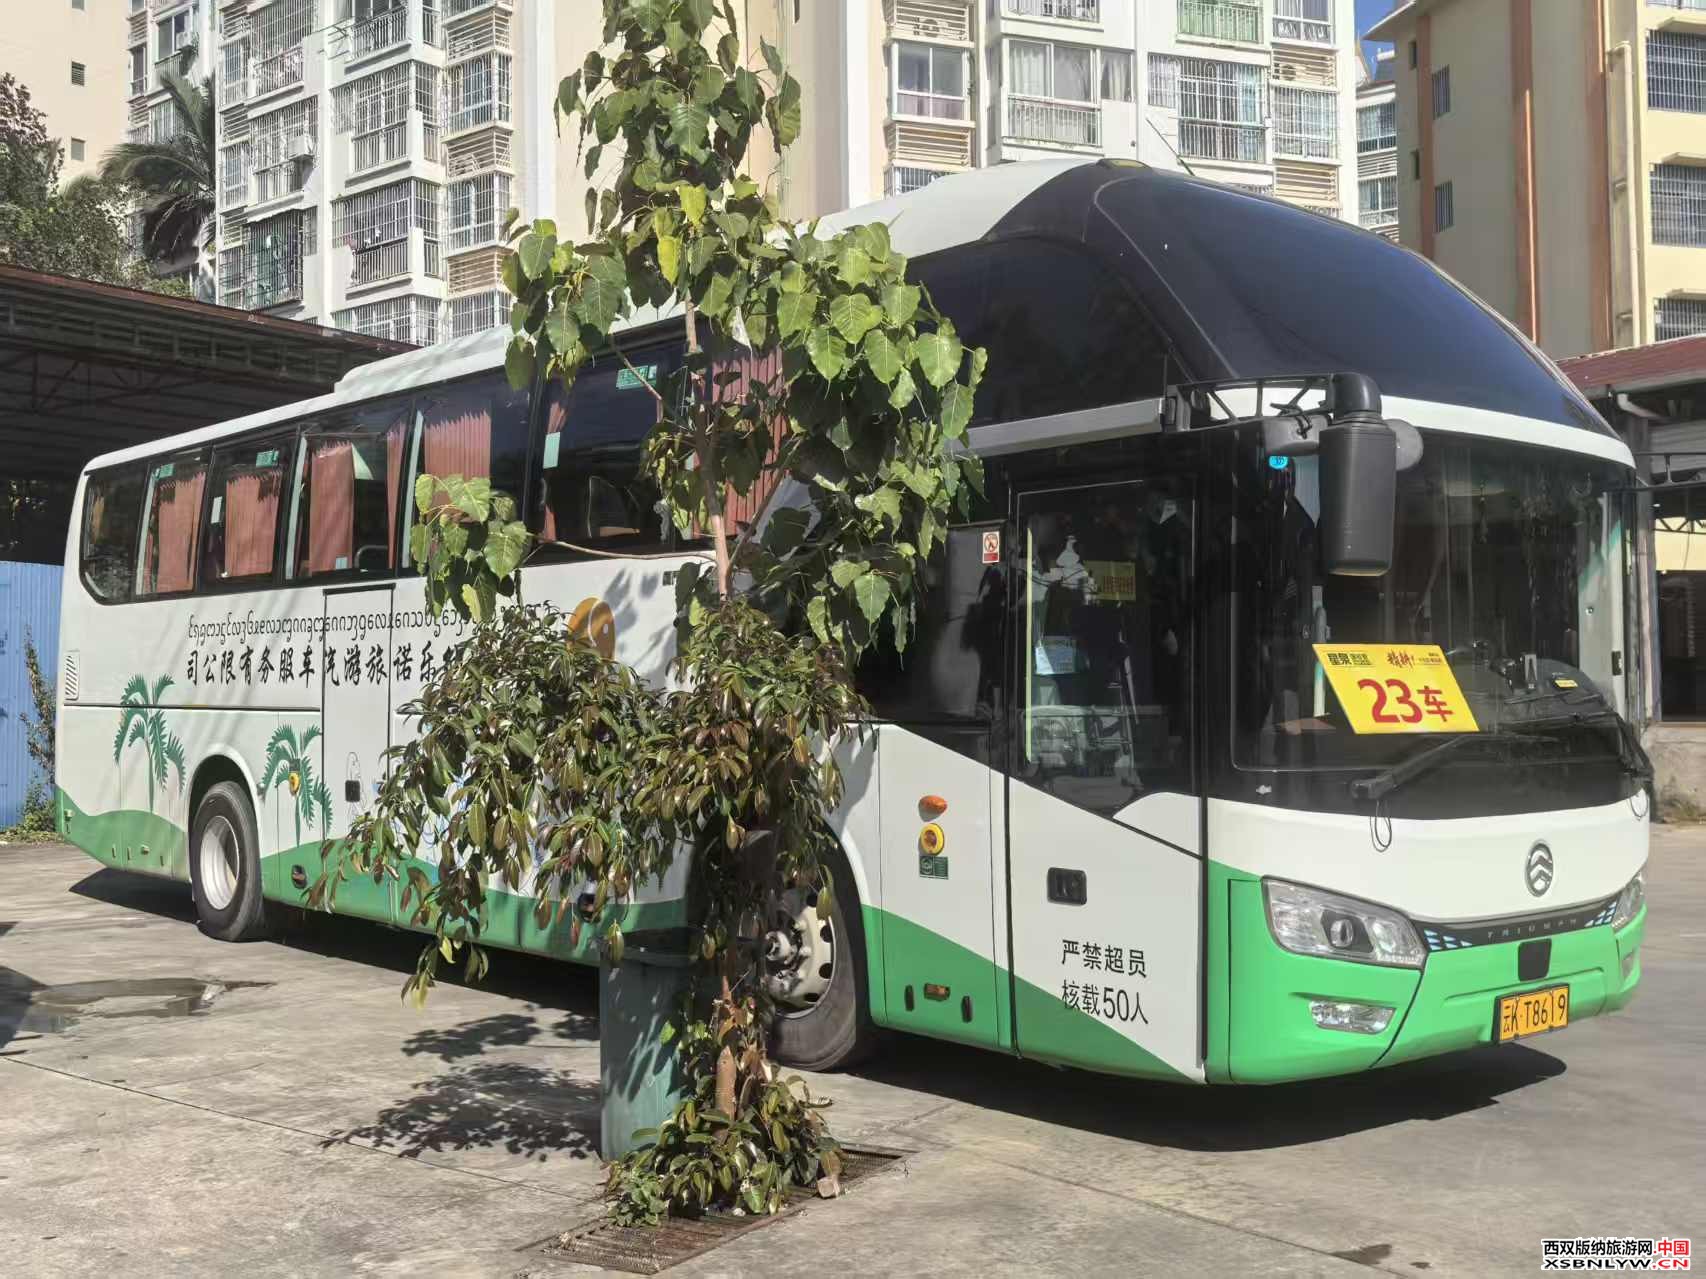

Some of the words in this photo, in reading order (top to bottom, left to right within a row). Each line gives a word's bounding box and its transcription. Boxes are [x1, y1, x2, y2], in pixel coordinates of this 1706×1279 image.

[1357, 678, 1453, 723] 23车
[1061, 939, 1146, 978] 严禁超员
[1061, 979, 1148, 1025] 核载50人
